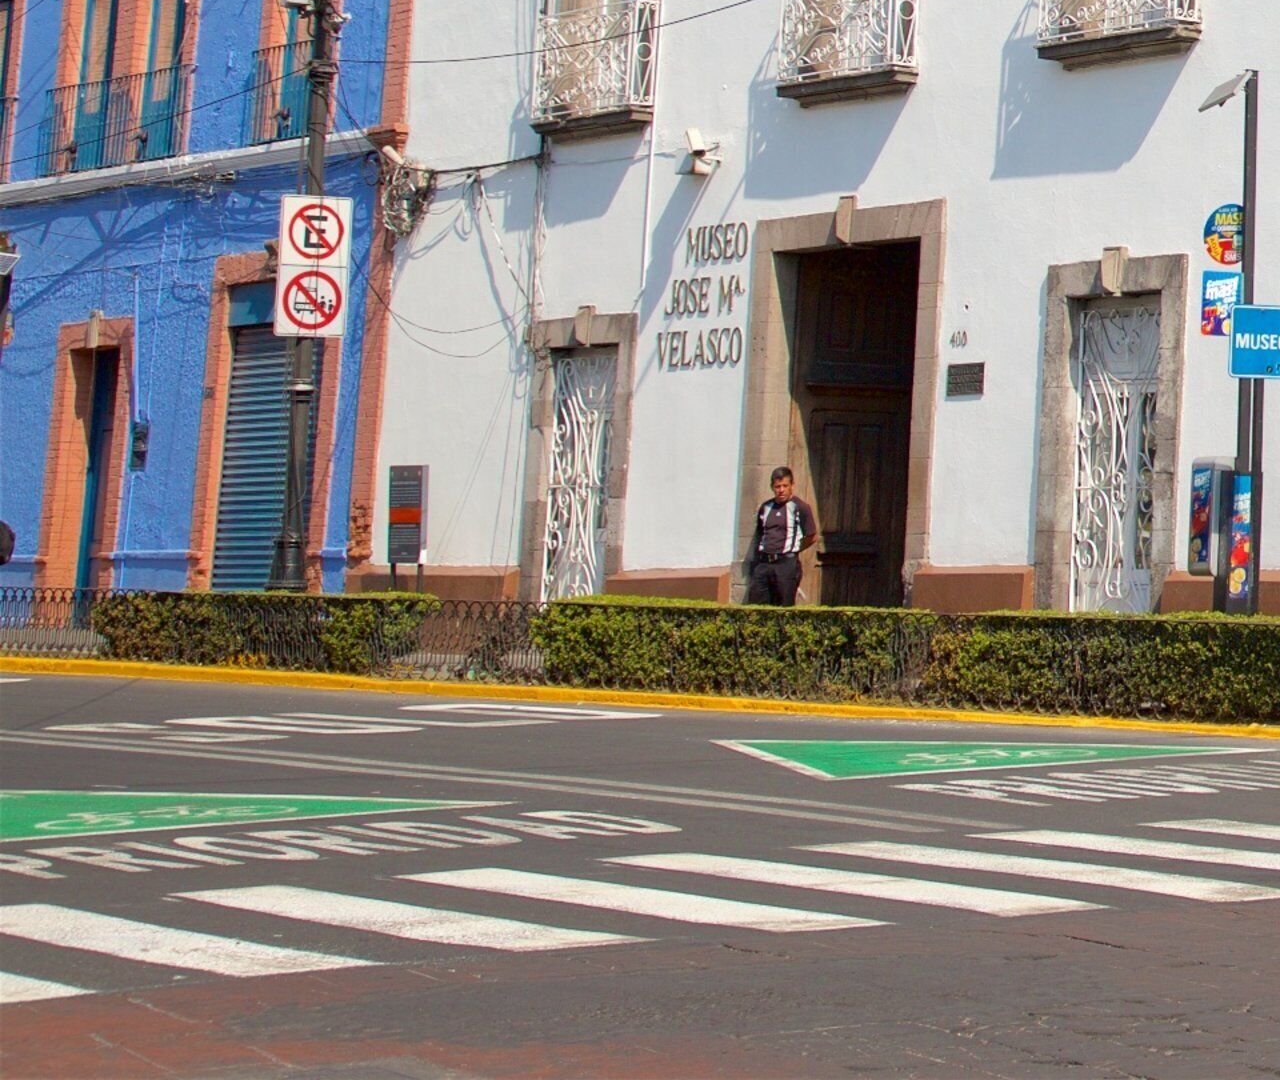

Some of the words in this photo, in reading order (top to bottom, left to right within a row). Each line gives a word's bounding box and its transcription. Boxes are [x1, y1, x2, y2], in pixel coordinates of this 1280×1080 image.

[686, 222, 749, 263] MUSEO
[665, 276, 711, 316] JOSE
[657, 327, 742, 369] VELASCO
[949, 330, 968, 348] 400
